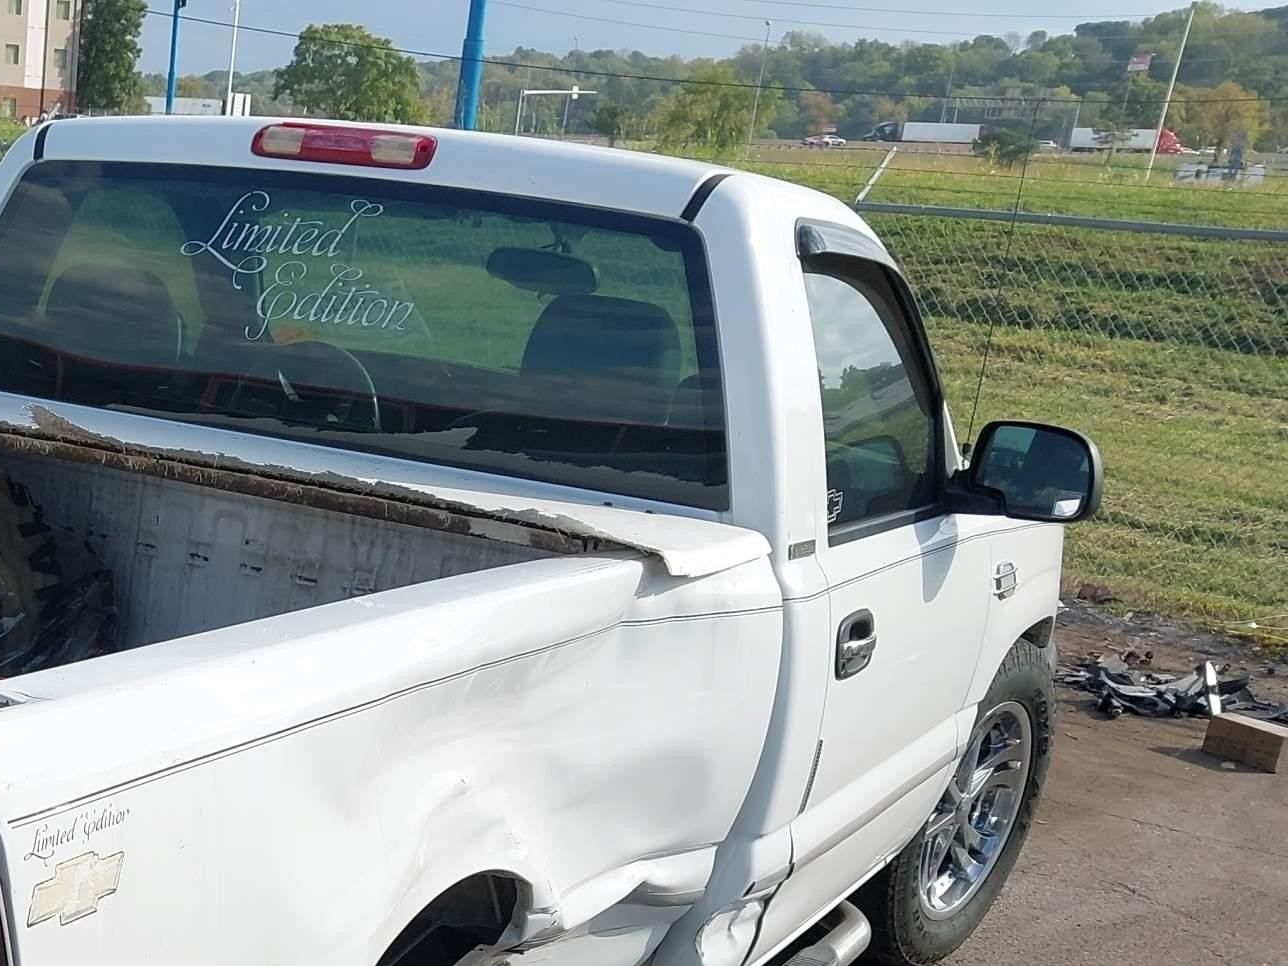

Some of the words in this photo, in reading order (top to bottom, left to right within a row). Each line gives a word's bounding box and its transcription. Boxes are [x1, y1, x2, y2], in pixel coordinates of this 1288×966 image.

[180, 190, 384, 290] Limited
[244, 261, 414, 341] Edition
[23, 816, 78, 867] Limited
[80, 803, 131, 844] Edition
